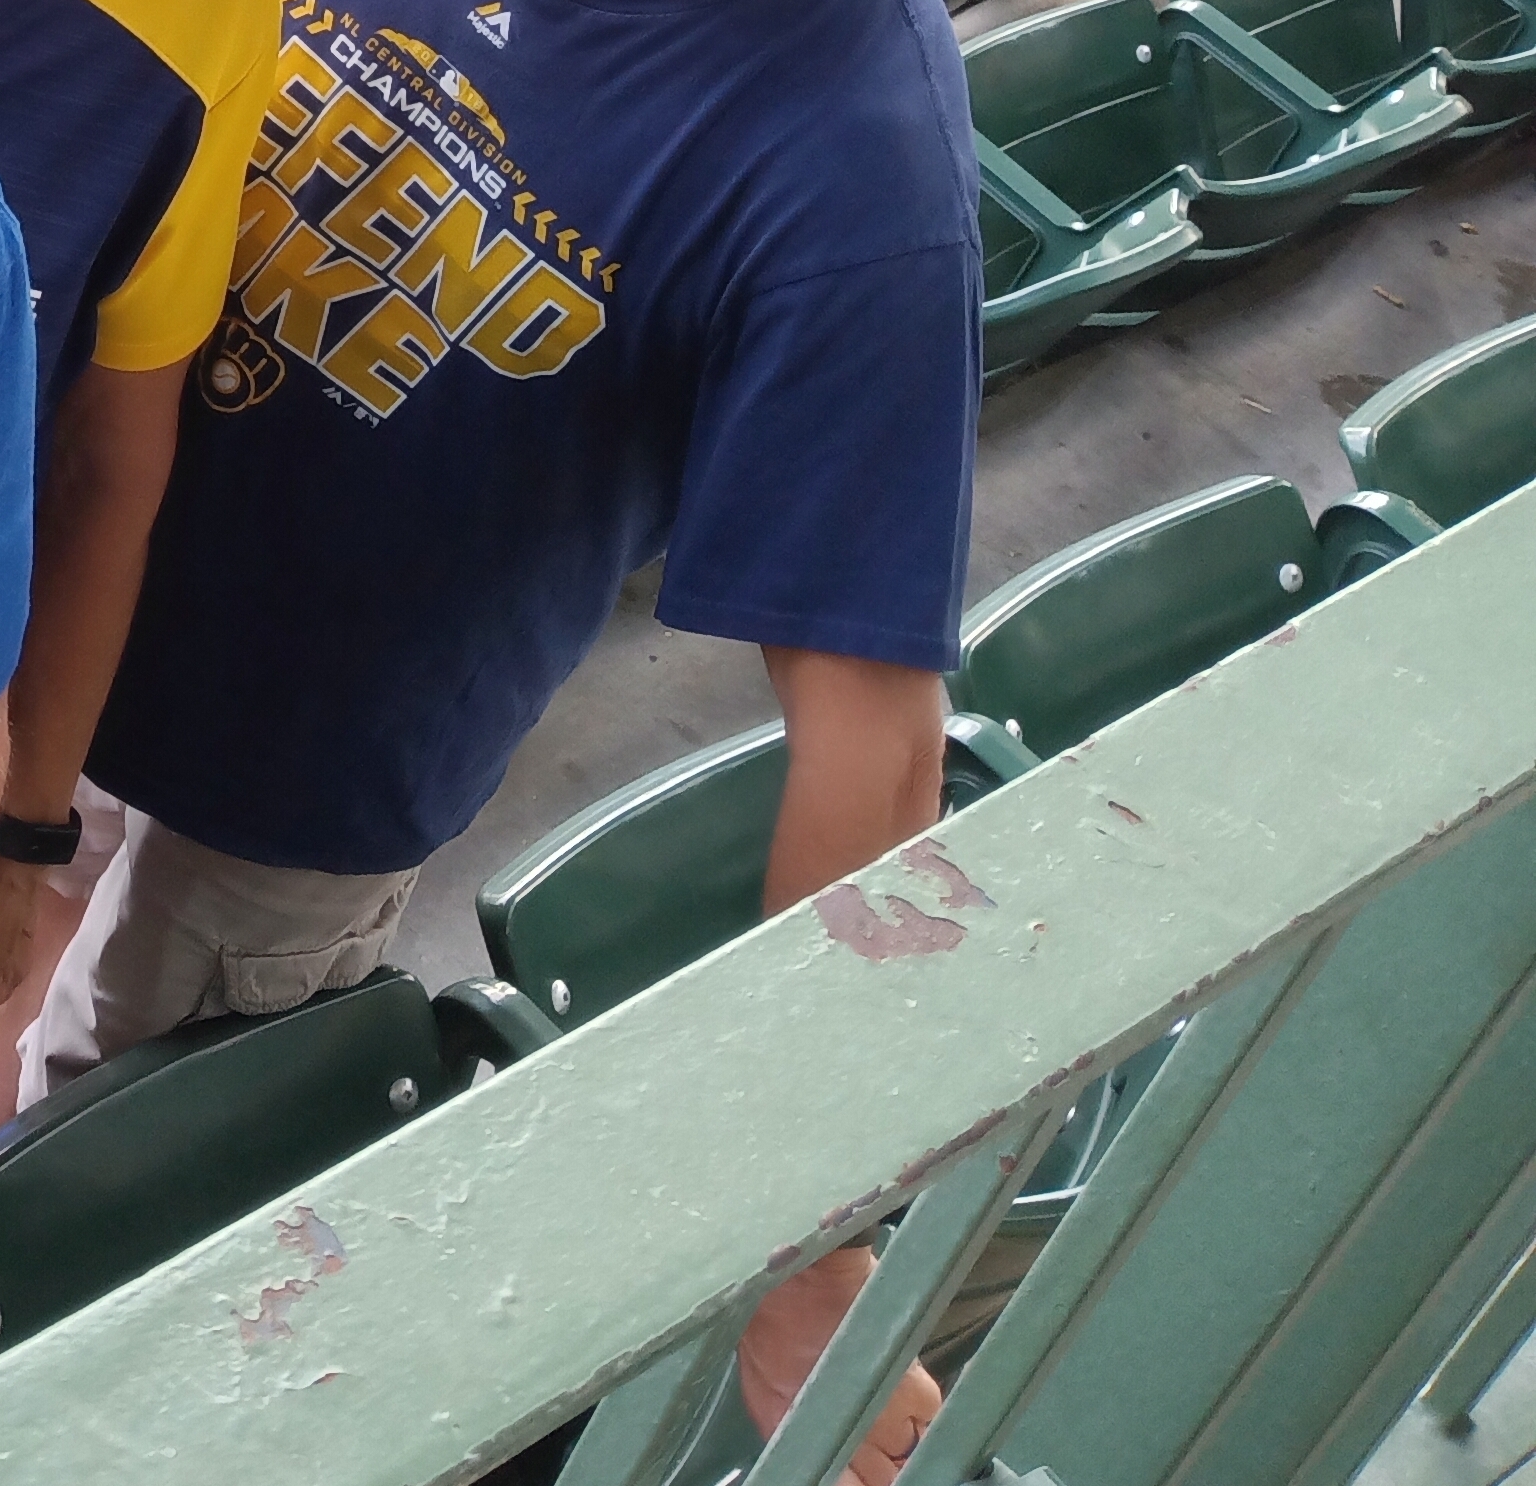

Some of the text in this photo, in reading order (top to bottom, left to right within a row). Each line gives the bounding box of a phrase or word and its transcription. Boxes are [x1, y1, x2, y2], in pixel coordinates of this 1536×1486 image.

[330, 33, 507, 200] CHAMPIONS
[339, 12, 527, 185] NL CENTRAL DIVISION
[247, 35, 607, 380] EFEND
